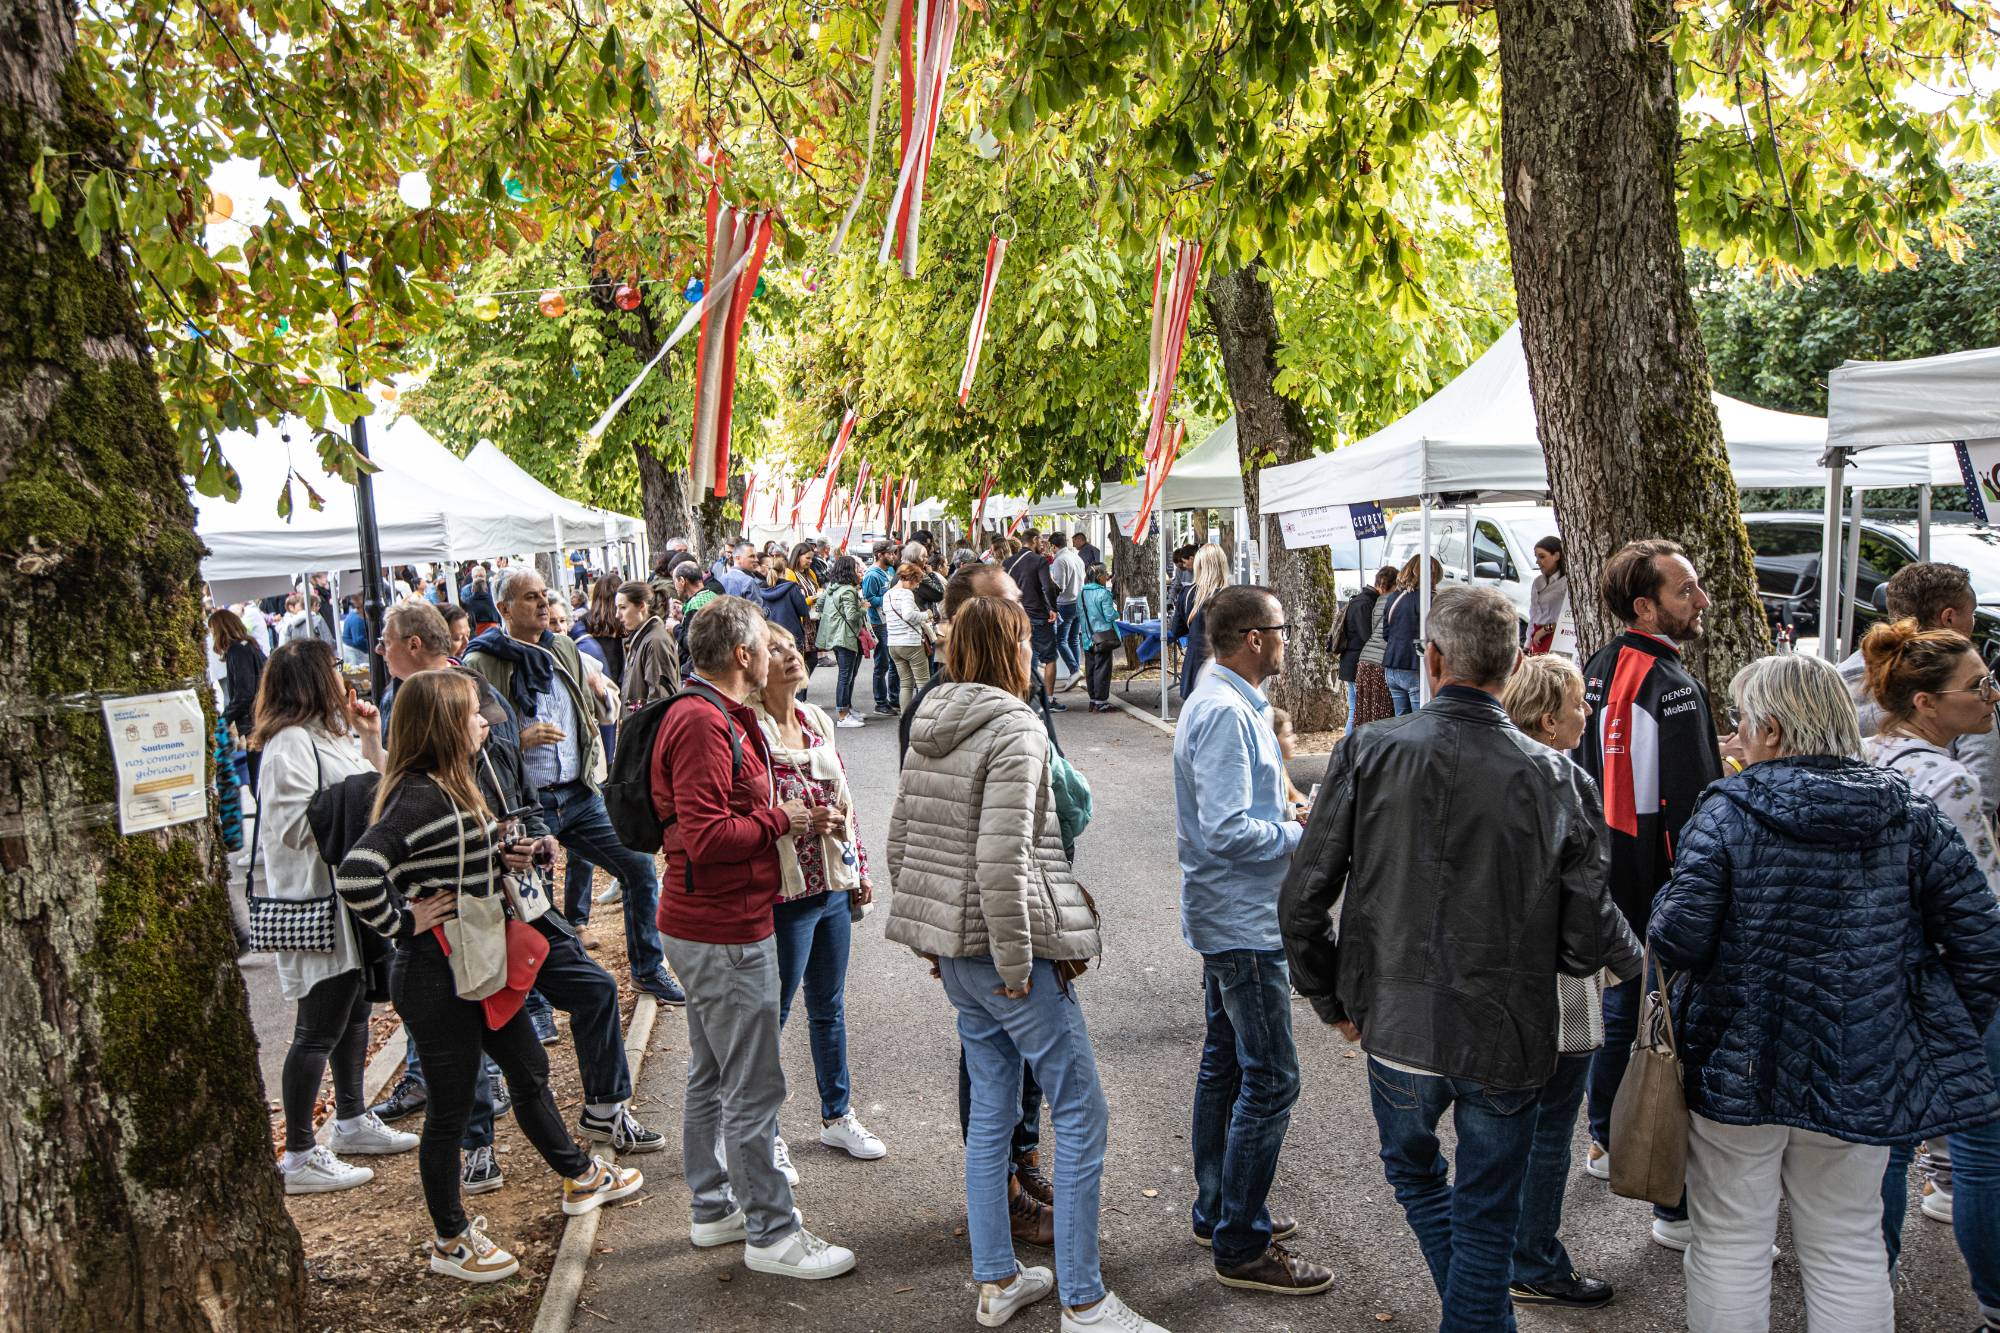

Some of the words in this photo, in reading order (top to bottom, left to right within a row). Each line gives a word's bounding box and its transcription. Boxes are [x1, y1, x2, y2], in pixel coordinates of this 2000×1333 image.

[1353, 512, 1382, 527] GEVREY
[1661, 687, 1692, 703] DENSO
[1663, 702, 1688, 717] Mobil
[141, 742, 184, 752] Soutenons
[125, 759, 144, 768] nos
[146, 750, 199, 764] commerces
